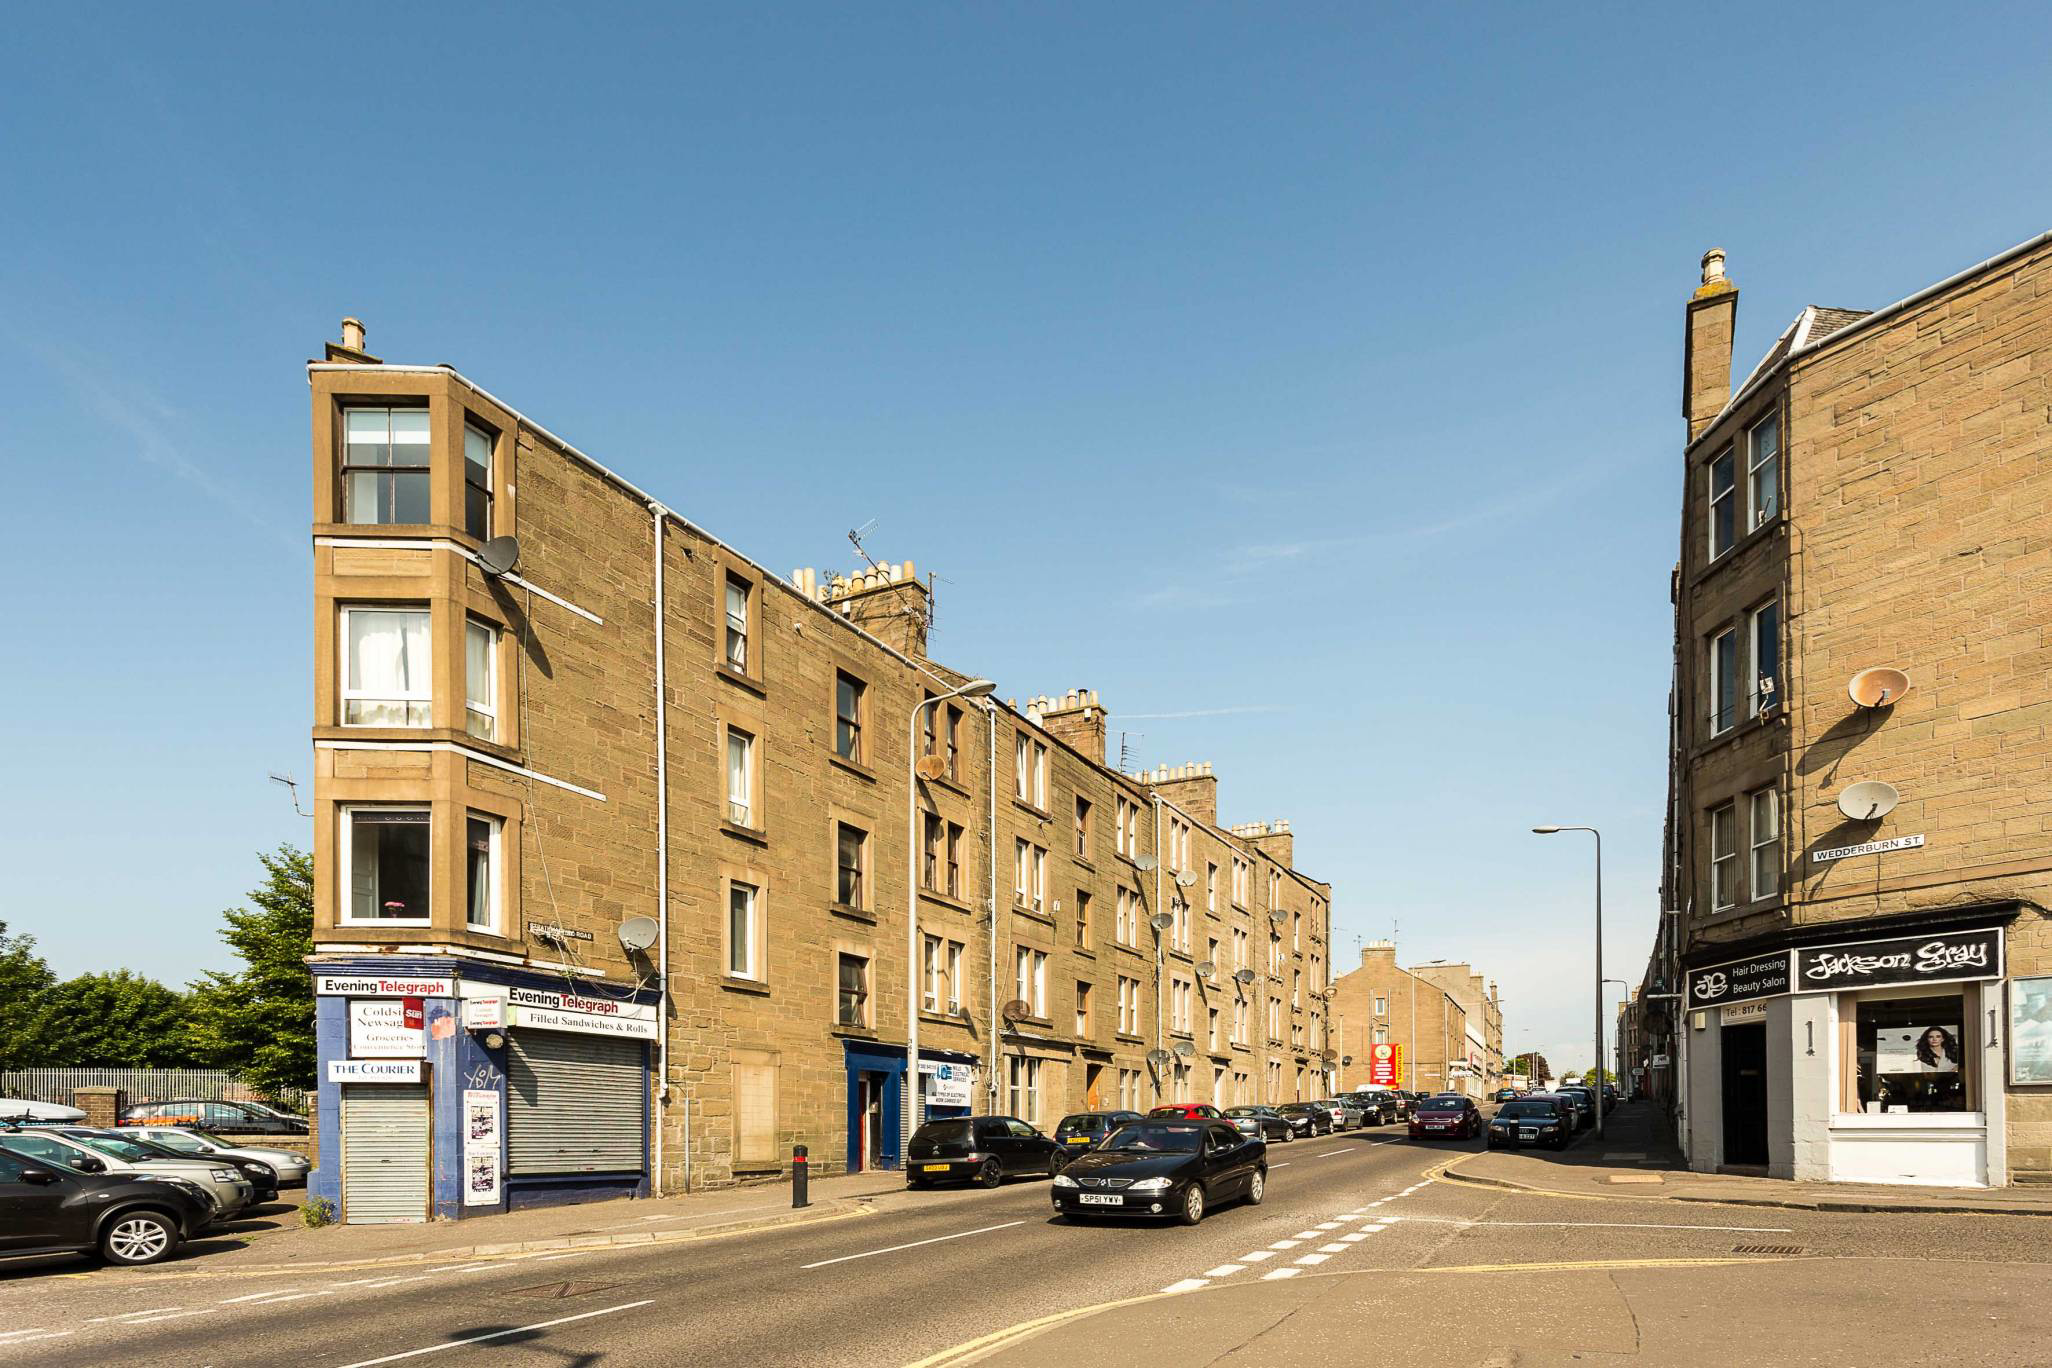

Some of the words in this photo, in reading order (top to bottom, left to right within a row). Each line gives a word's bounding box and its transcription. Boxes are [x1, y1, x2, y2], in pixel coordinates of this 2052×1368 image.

[1817, 839, 1899, 860] WEDDERBURN
[1732, 965, 1748, 978] Hair
[1750, 959, 1786, 974] Dressing
[1805, 953, 1912, 980] Jackson
[1913, 941, 1988, 972] Gray
[325, 979, 378, 994] Evening
[379, 980, 445, 995] Telegraph
[1733, 981, 1760, 994] Beauty
[1762, 977, 1786, 988] Salon
[509, 987, 560, 1008] Evening
[560, 994, 619, 1014] Telegraph
[363, 1007, 402, 1018] Coldsi
[405, 1008, 422, 1019] Sun
[1742, 1005, 1755, 1015] 817
[530, 1013, 559, 1025] Filled
[561, 1014, 615, 1032] Sandwiches
[616, 1023, 624, 1032] &
[626, 1023, 648, 1034] Rolls
[366, 1033, 414, 1042] Groceries
[334, 1064, 358, 1075] THE
